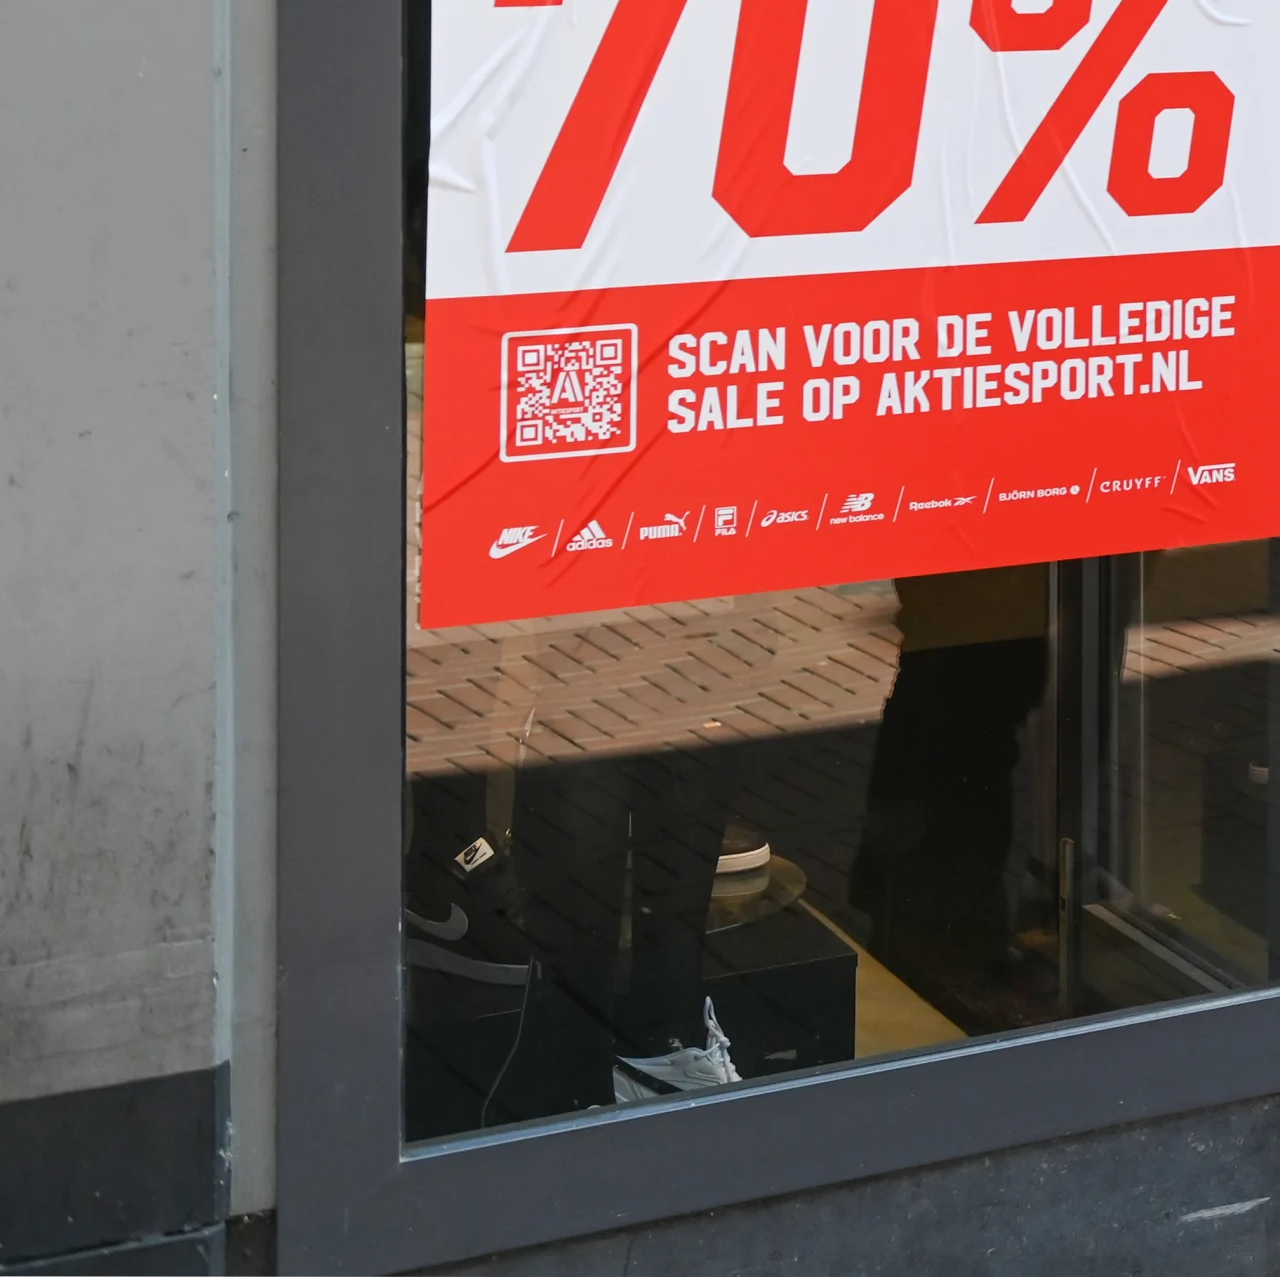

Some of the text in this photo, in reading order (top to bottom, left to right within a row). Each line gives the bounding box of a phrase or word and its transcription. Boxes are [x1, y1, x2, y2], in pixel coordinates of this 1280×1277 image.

[666, 295, 1236, 379] SCAN VOOR DE VOLLEDIGE
[665, 350, 1204, 434] SALE OP AKTIESPORT.NL
[1187, 462, 1237, 486] VANS
[1100, 476, 1162, 493] CRUYFF
[999, 486, 1068, 502] BJÖRN BORG
[909, 497, 953, 511] Reebok
[775, 510, 808, 524] asics
[829, 512, 885, 525] new balance
[499, 525, 539, 545] NIKE
[639, 525, 680, 541] PUMA
[715, 526, 737, 537] FILA
[566, 537, 614, 552] adidas
